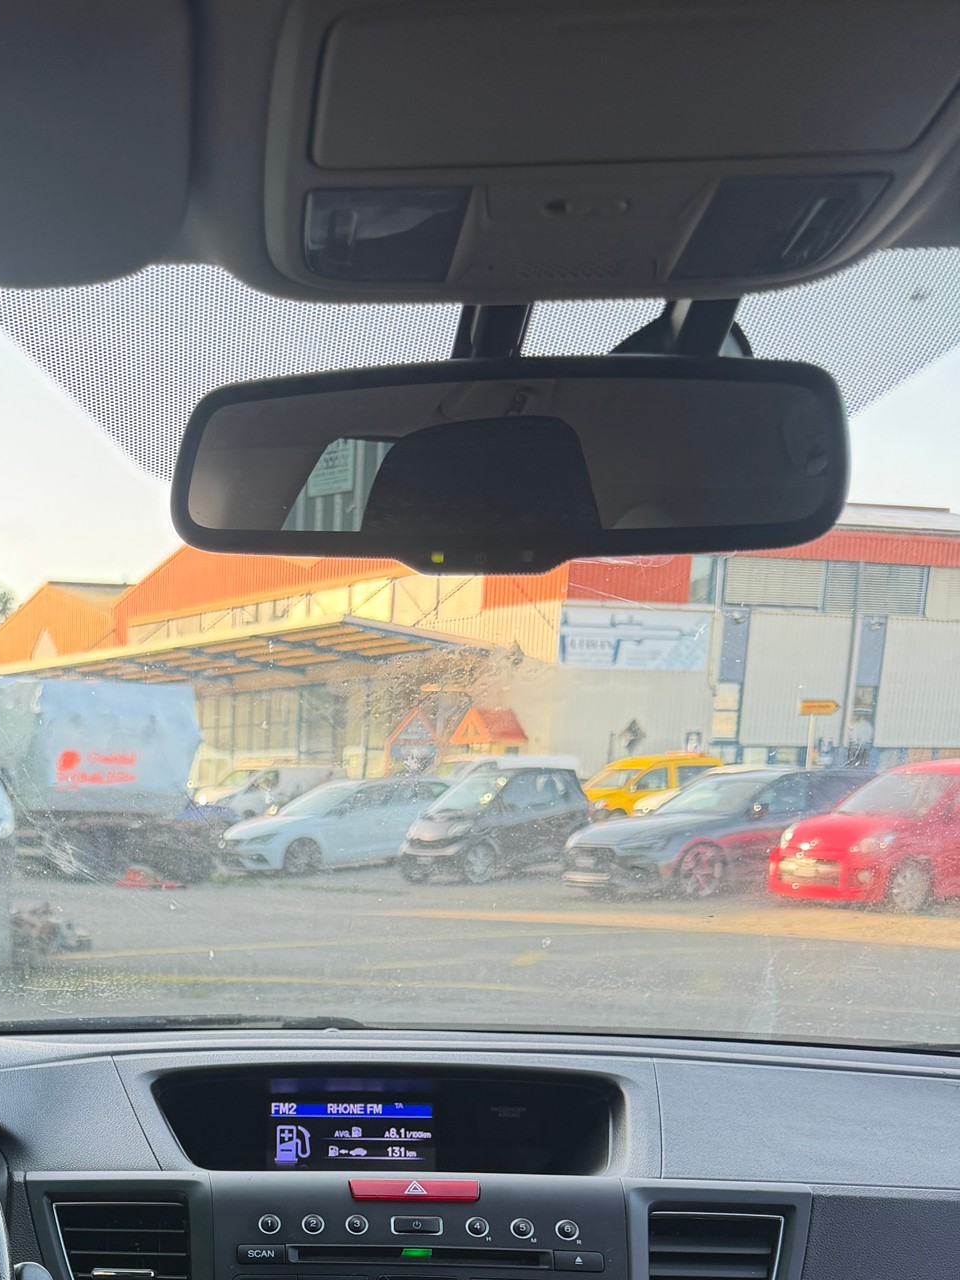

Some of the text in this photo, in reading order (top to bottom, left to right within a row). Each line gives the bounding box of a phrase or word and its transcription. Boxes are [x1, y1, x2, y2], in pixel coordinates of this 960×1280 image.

[271, 1103, 297, 1115] FM2
[327, 1103, 383, 1115] RHONE FM
[387, 1146, 405, 1158] 131
[266, 1219, 272, 1228] 1
[310, 1219, 317, 1228] 2
[353, 1219, 361, 1228] 3
[473, 1221, 481, 1231] 4
[519, 1223, 526, 1232] 5
[564, 1225, 571, 1234] 6
[247, 1249, 275, 1258] SCAN
